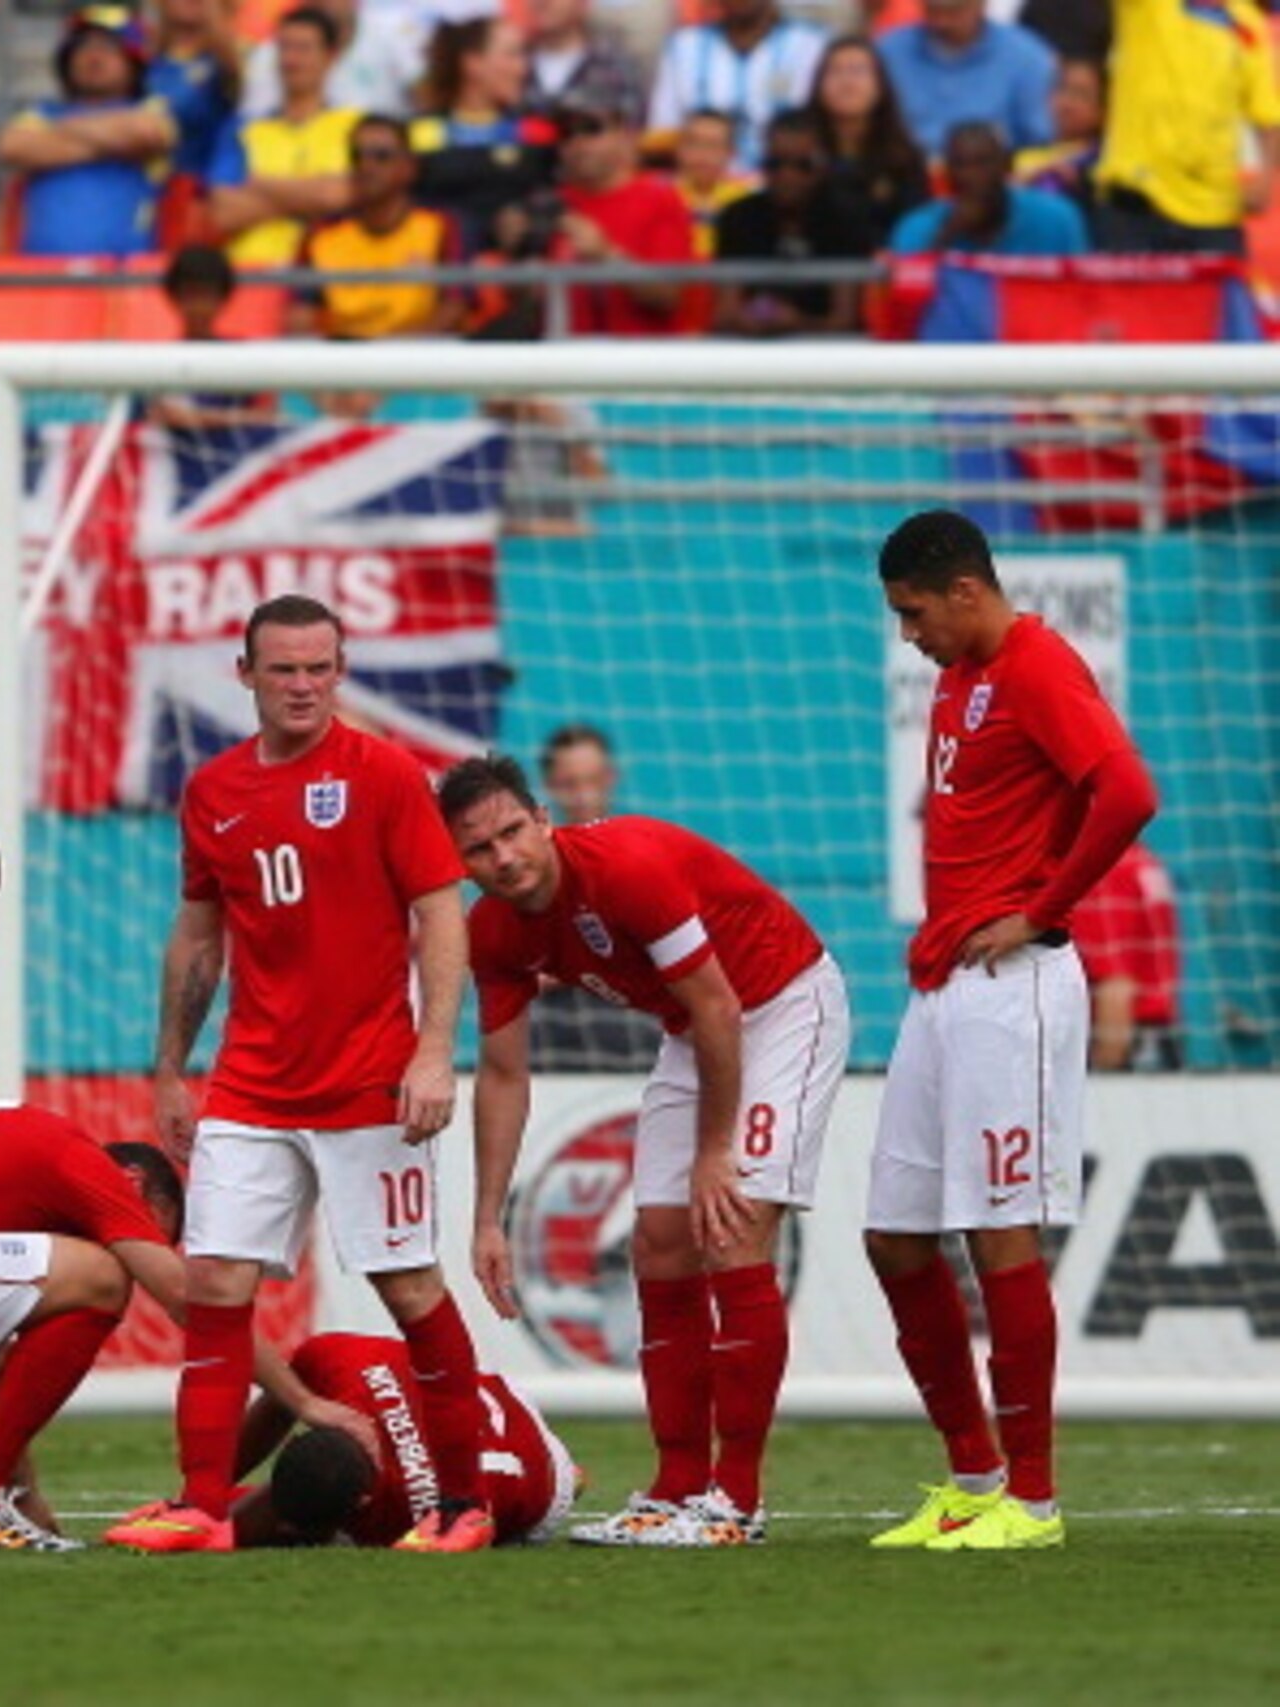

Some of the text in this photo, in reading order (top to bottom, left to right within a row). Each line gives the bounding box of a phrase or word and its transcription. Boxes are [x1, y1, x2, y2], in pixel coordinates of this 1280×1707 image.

[147, 552, 400, 634] RAMS
[252, 843, 304, 908] 10
[743, 1102, 775, 1158] 8
[981, 1125, 1032, 1187] 12
[378, 1165, 424, 1230] 10
